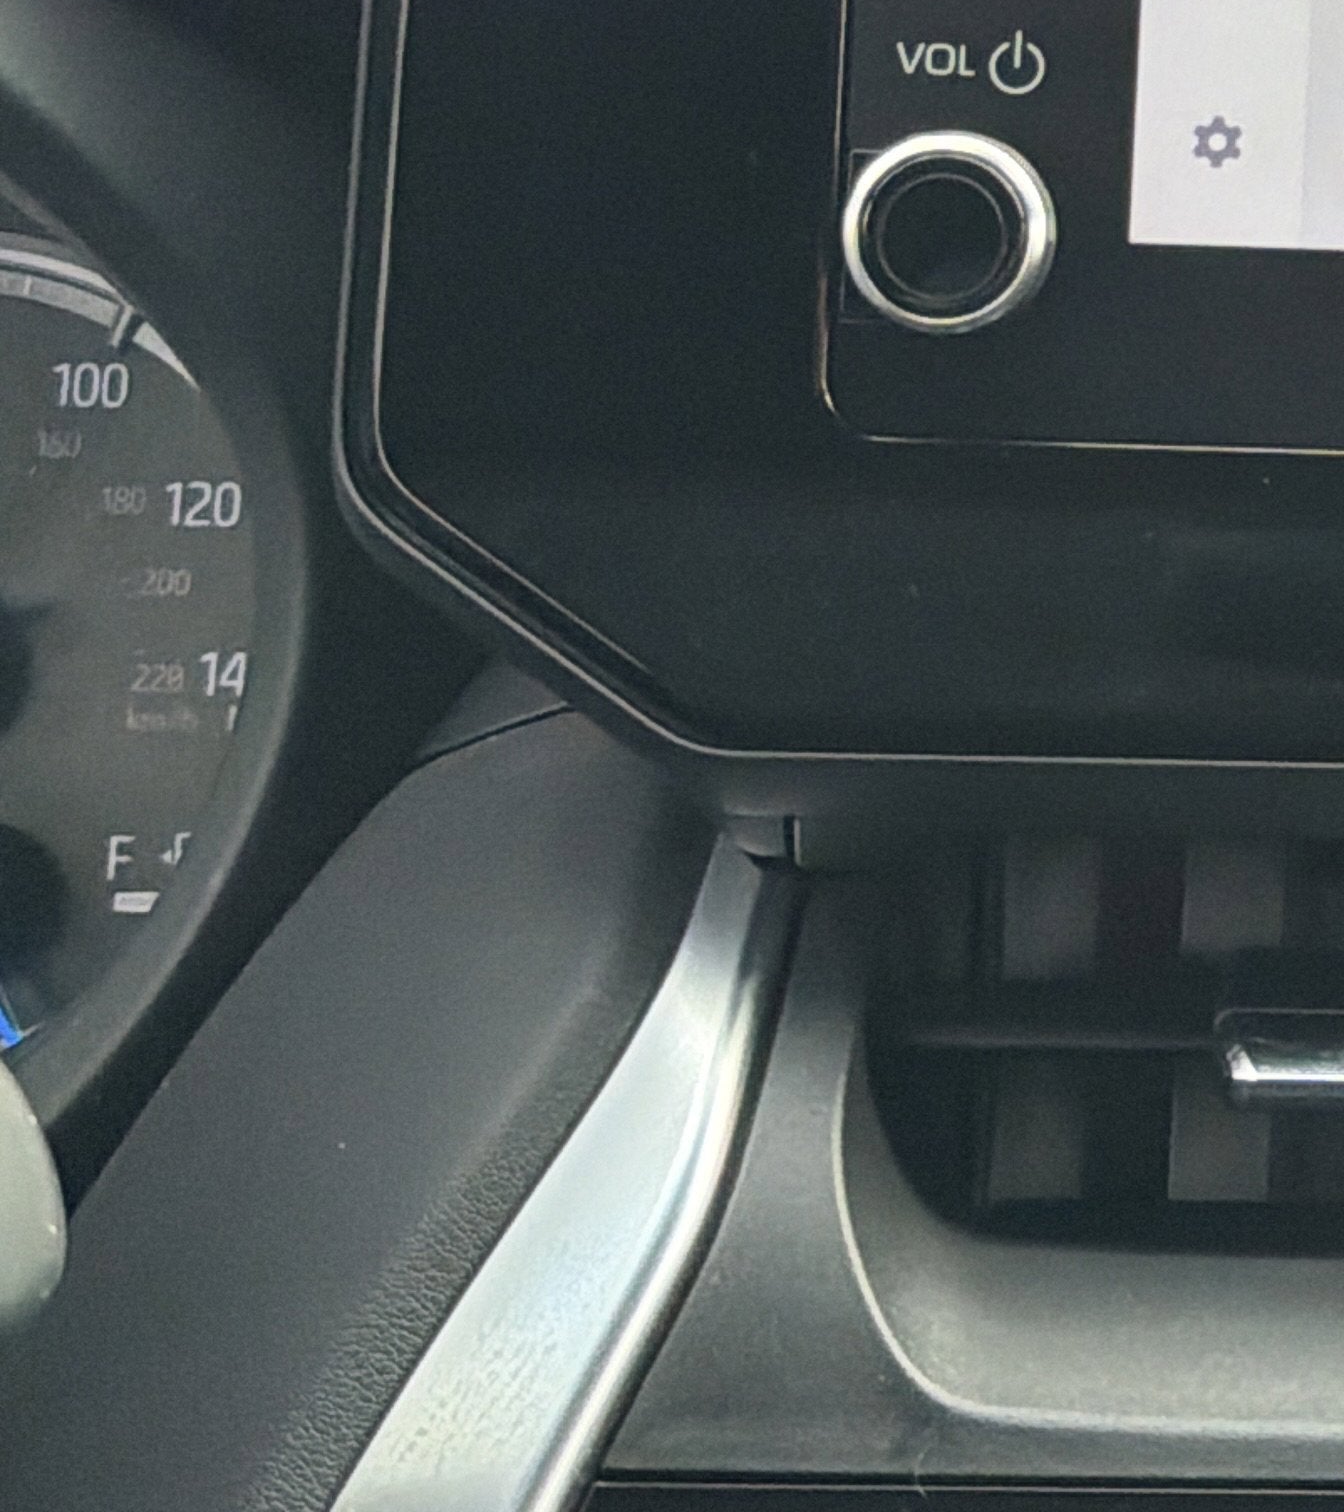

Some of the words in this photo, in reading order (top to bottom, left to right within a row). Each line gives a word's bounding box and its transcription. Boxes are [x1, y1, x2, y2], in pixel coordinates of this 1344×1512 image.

[896, 41, 976, 77] VOL
[53, 362, 129, 408] 100
[165, 481, 242, 527] 120
[141, 568, 191, 596] 200
[200, 651, 247, 697] 14
[106, 835, 135, 880] F
